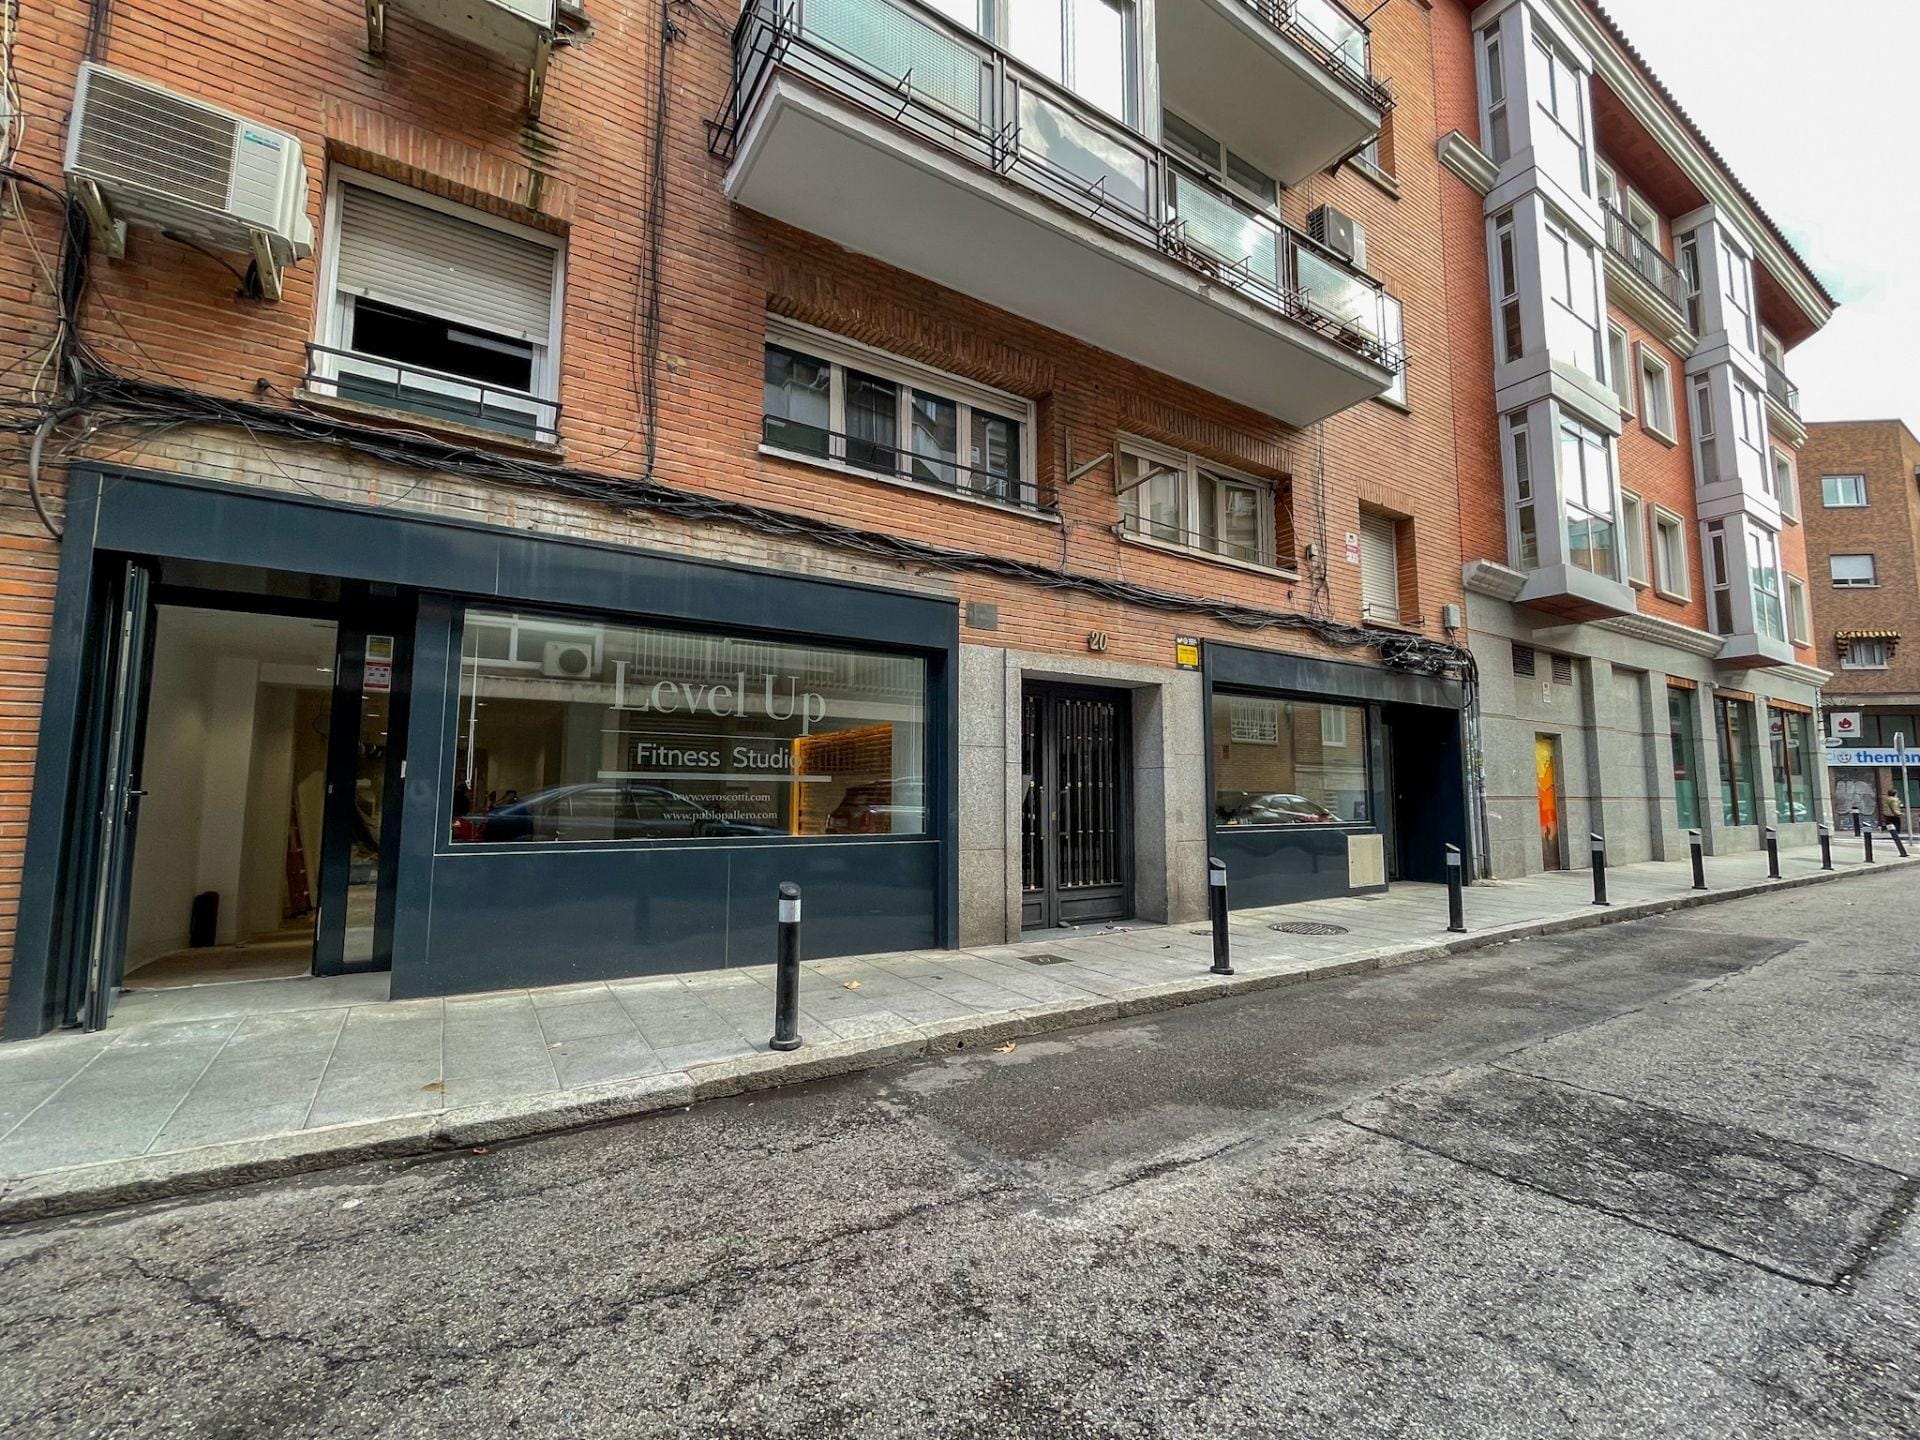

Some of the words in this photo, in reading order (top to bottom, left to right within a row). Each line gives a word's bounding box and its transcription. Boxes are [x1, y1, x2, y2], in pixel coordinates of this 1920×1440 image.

[1090, 631, 1108, 651] 20
[609, 660, 748, 718] Level
[761, 673, 826, 737] Up
[637, 743, 721, 767] Fitness
[733, 746, 802, 769] Studio
[672, 792, 771, 802] www.veroscotti.com
